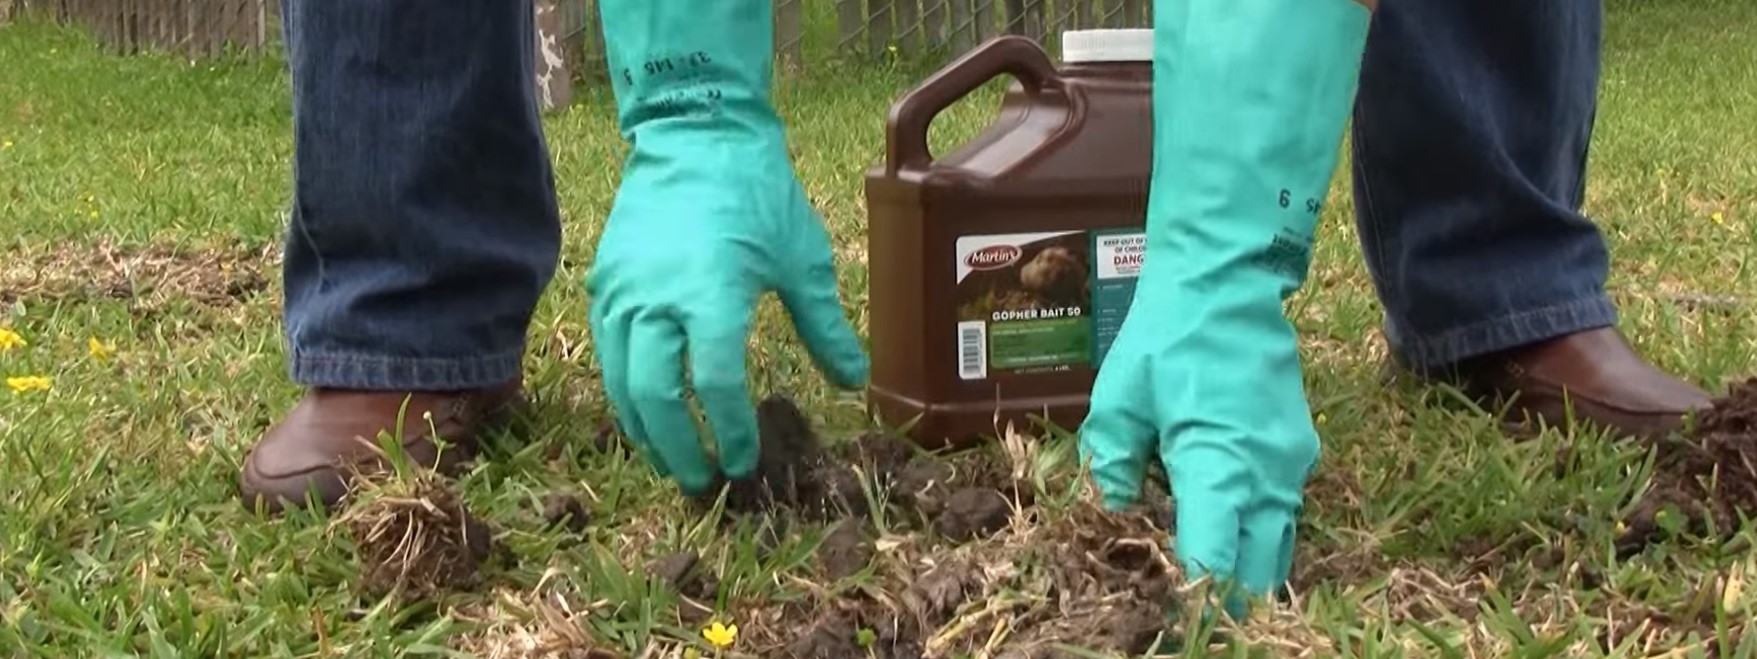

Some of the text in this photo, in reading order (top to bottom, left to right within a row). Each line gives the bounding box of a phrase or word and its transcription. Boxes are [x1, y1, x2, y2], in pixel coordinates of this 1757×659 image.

[1121, 237, 1134, 245] OUT
[992, 306, 1081, 321] GOPHER BAIT 50
